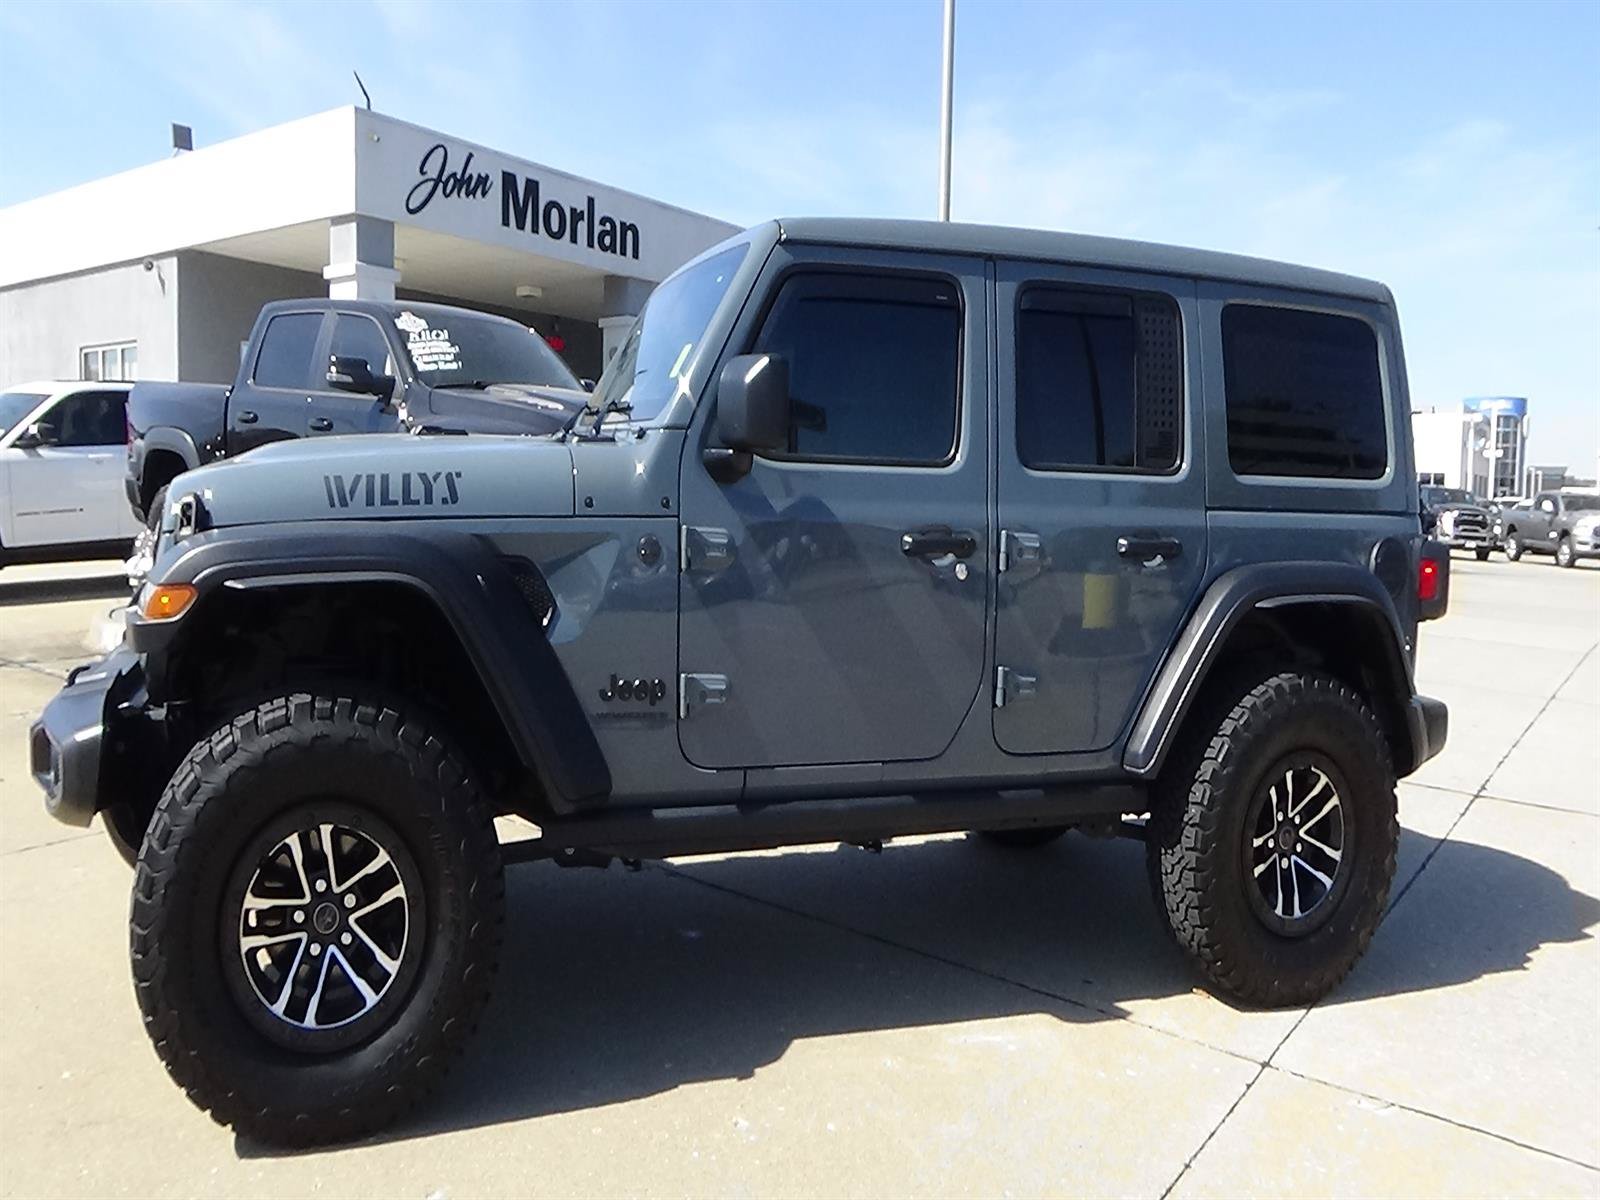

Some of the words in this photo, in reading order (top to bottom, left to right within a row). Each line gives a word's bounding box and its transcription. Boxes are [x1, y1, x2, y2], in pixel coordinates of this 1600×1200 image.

[405, 143, 494, 215] John
[501, 169, 640, 260] Morlan
[323, 471, 462, 509] WILLYS
[599, 673, 667, 707] Jeep
